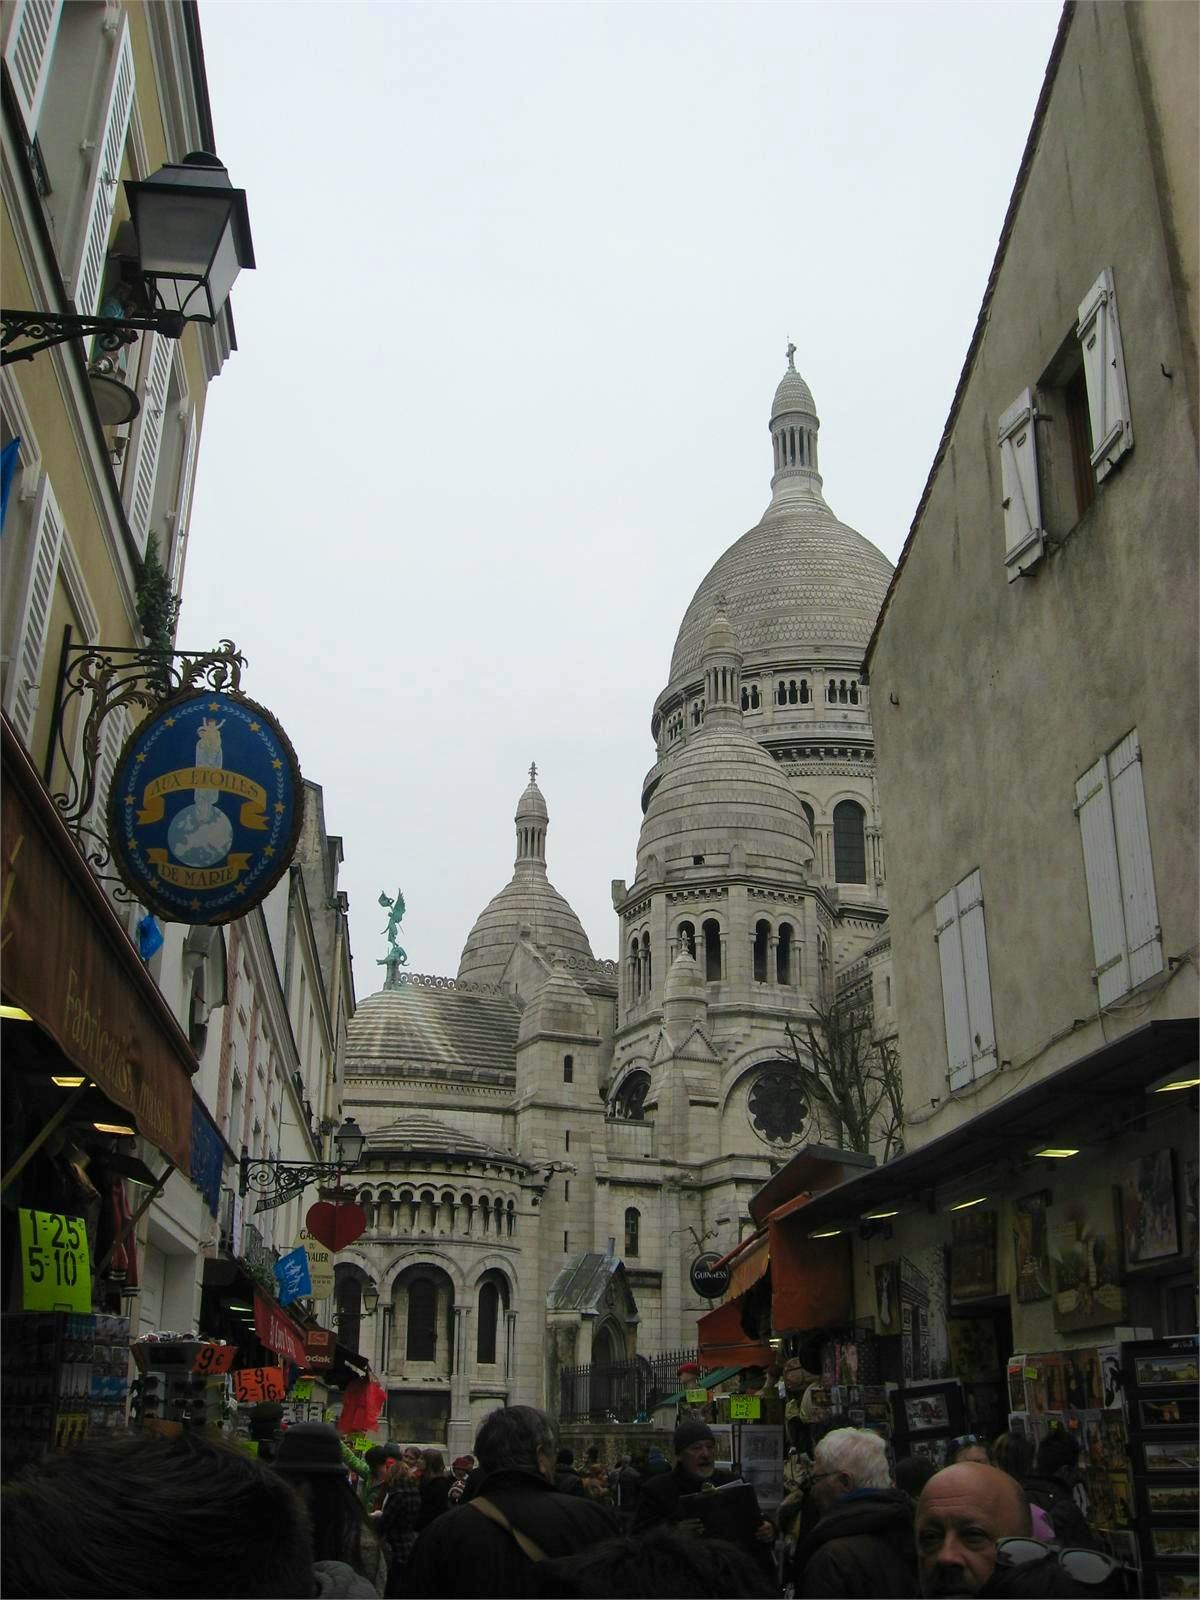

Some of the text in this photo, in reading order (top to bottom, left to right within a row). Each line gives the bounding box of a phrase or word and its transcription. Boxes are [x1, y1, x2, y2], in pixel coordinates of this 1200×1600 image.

[151, 773, 182, 796] AUX
[161, 865, 234, 887] DE MARIE
[694, 1271, 727, 1280] GUINNESS
[305, 1354, 331, 1364] odak
